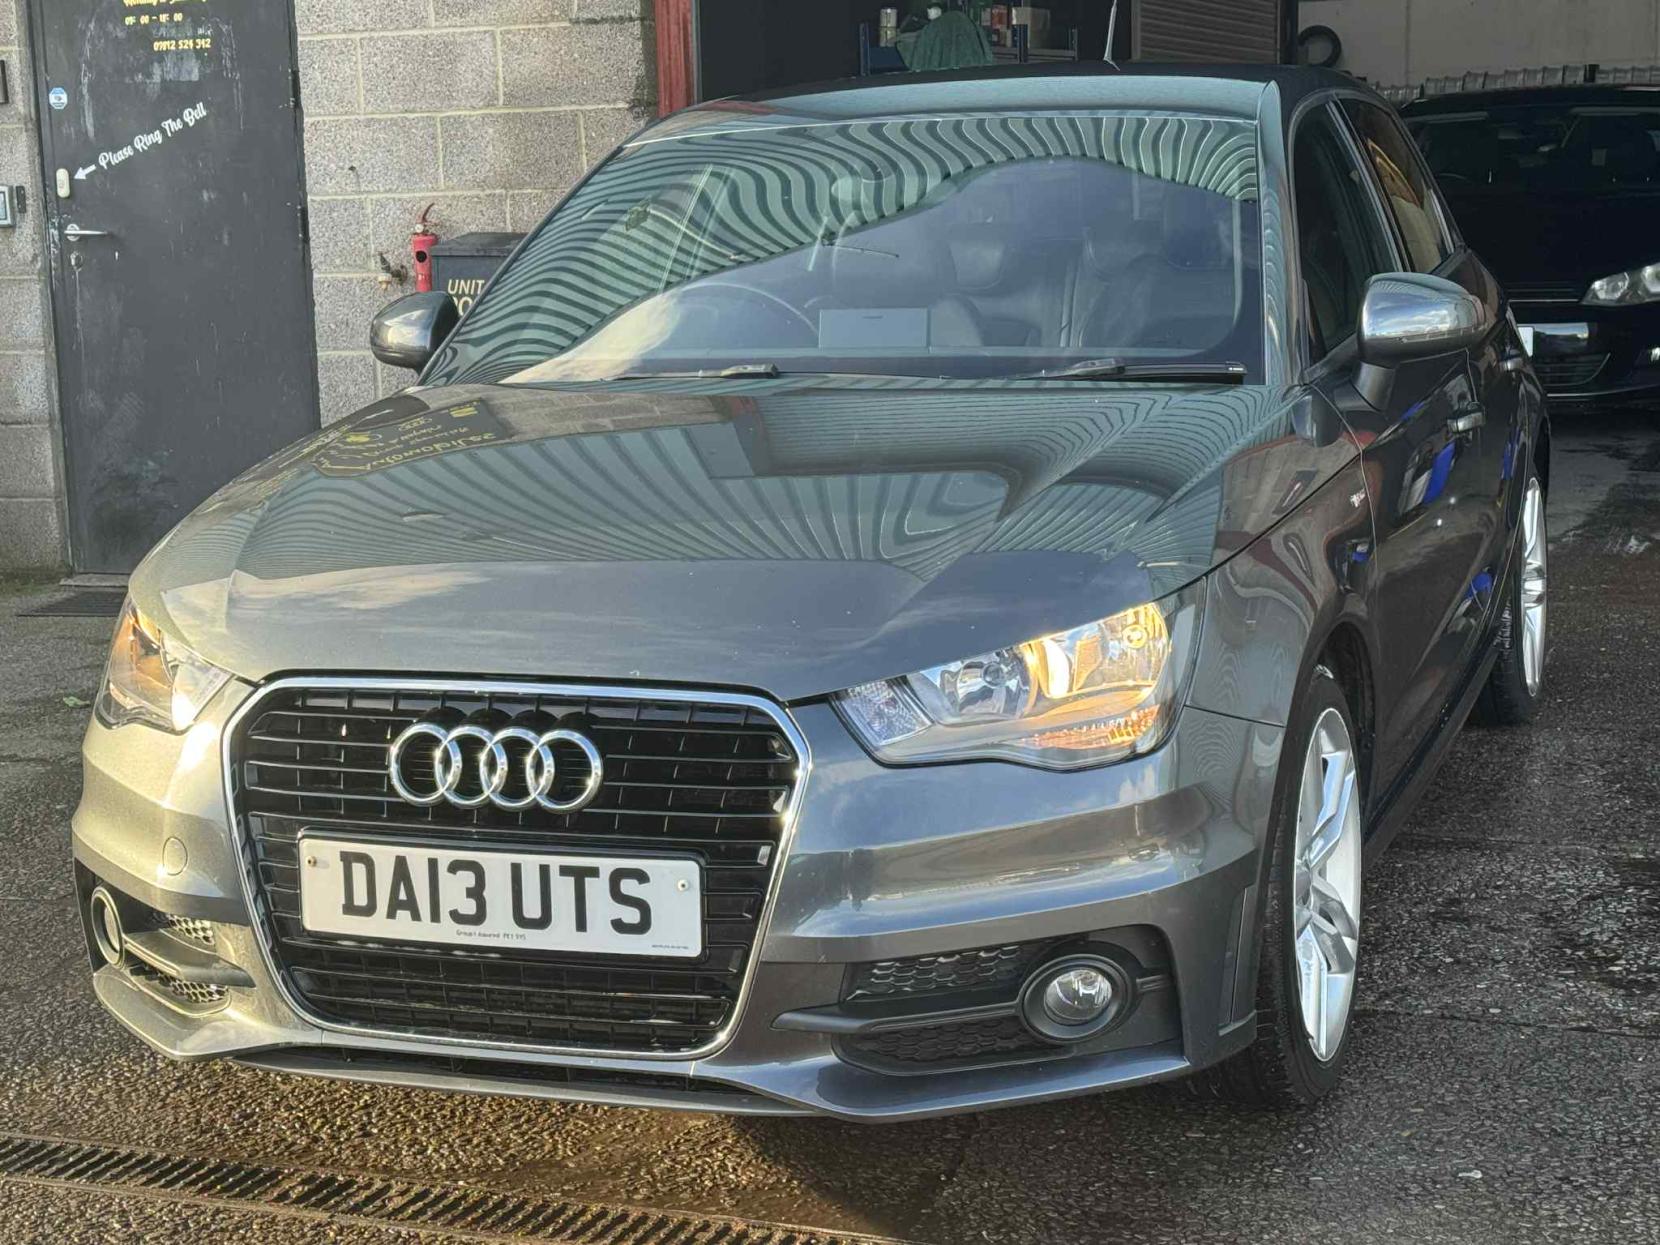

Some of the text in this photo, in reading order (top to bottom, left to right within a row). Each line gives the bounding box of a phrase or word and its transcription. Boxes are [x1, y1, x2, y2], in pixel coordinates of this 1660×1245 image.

[98, 102, 207, 170] Please Ring The Bell
[447, 279, 485, 295] UNIT
[340, 851, 653, 936] DA13 UTS
